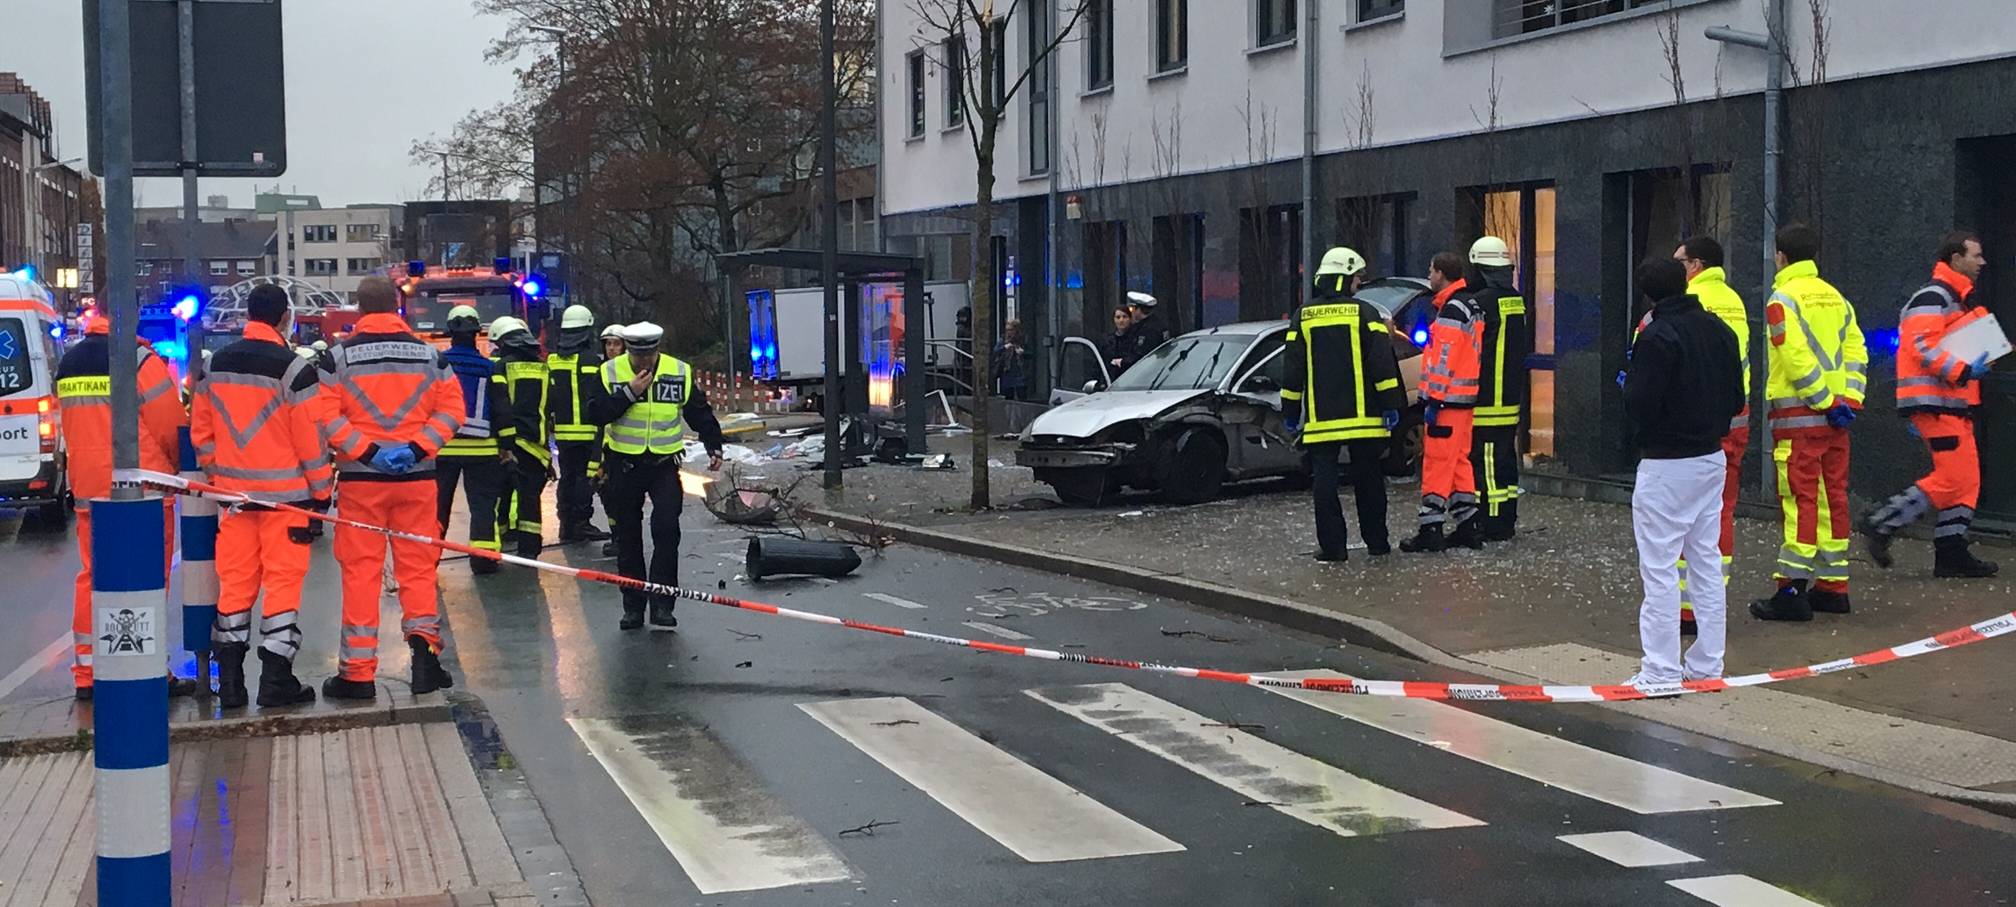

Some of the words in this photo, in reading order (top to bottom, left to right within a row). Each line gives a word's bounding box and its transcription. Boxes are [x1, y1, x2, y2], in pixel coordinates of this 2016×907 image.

[1303, 306, 1358, 318] FEUERWEHR
[351, 343, 426, 353] FEUERWEHR
[0, 427, 28, 440] ort
